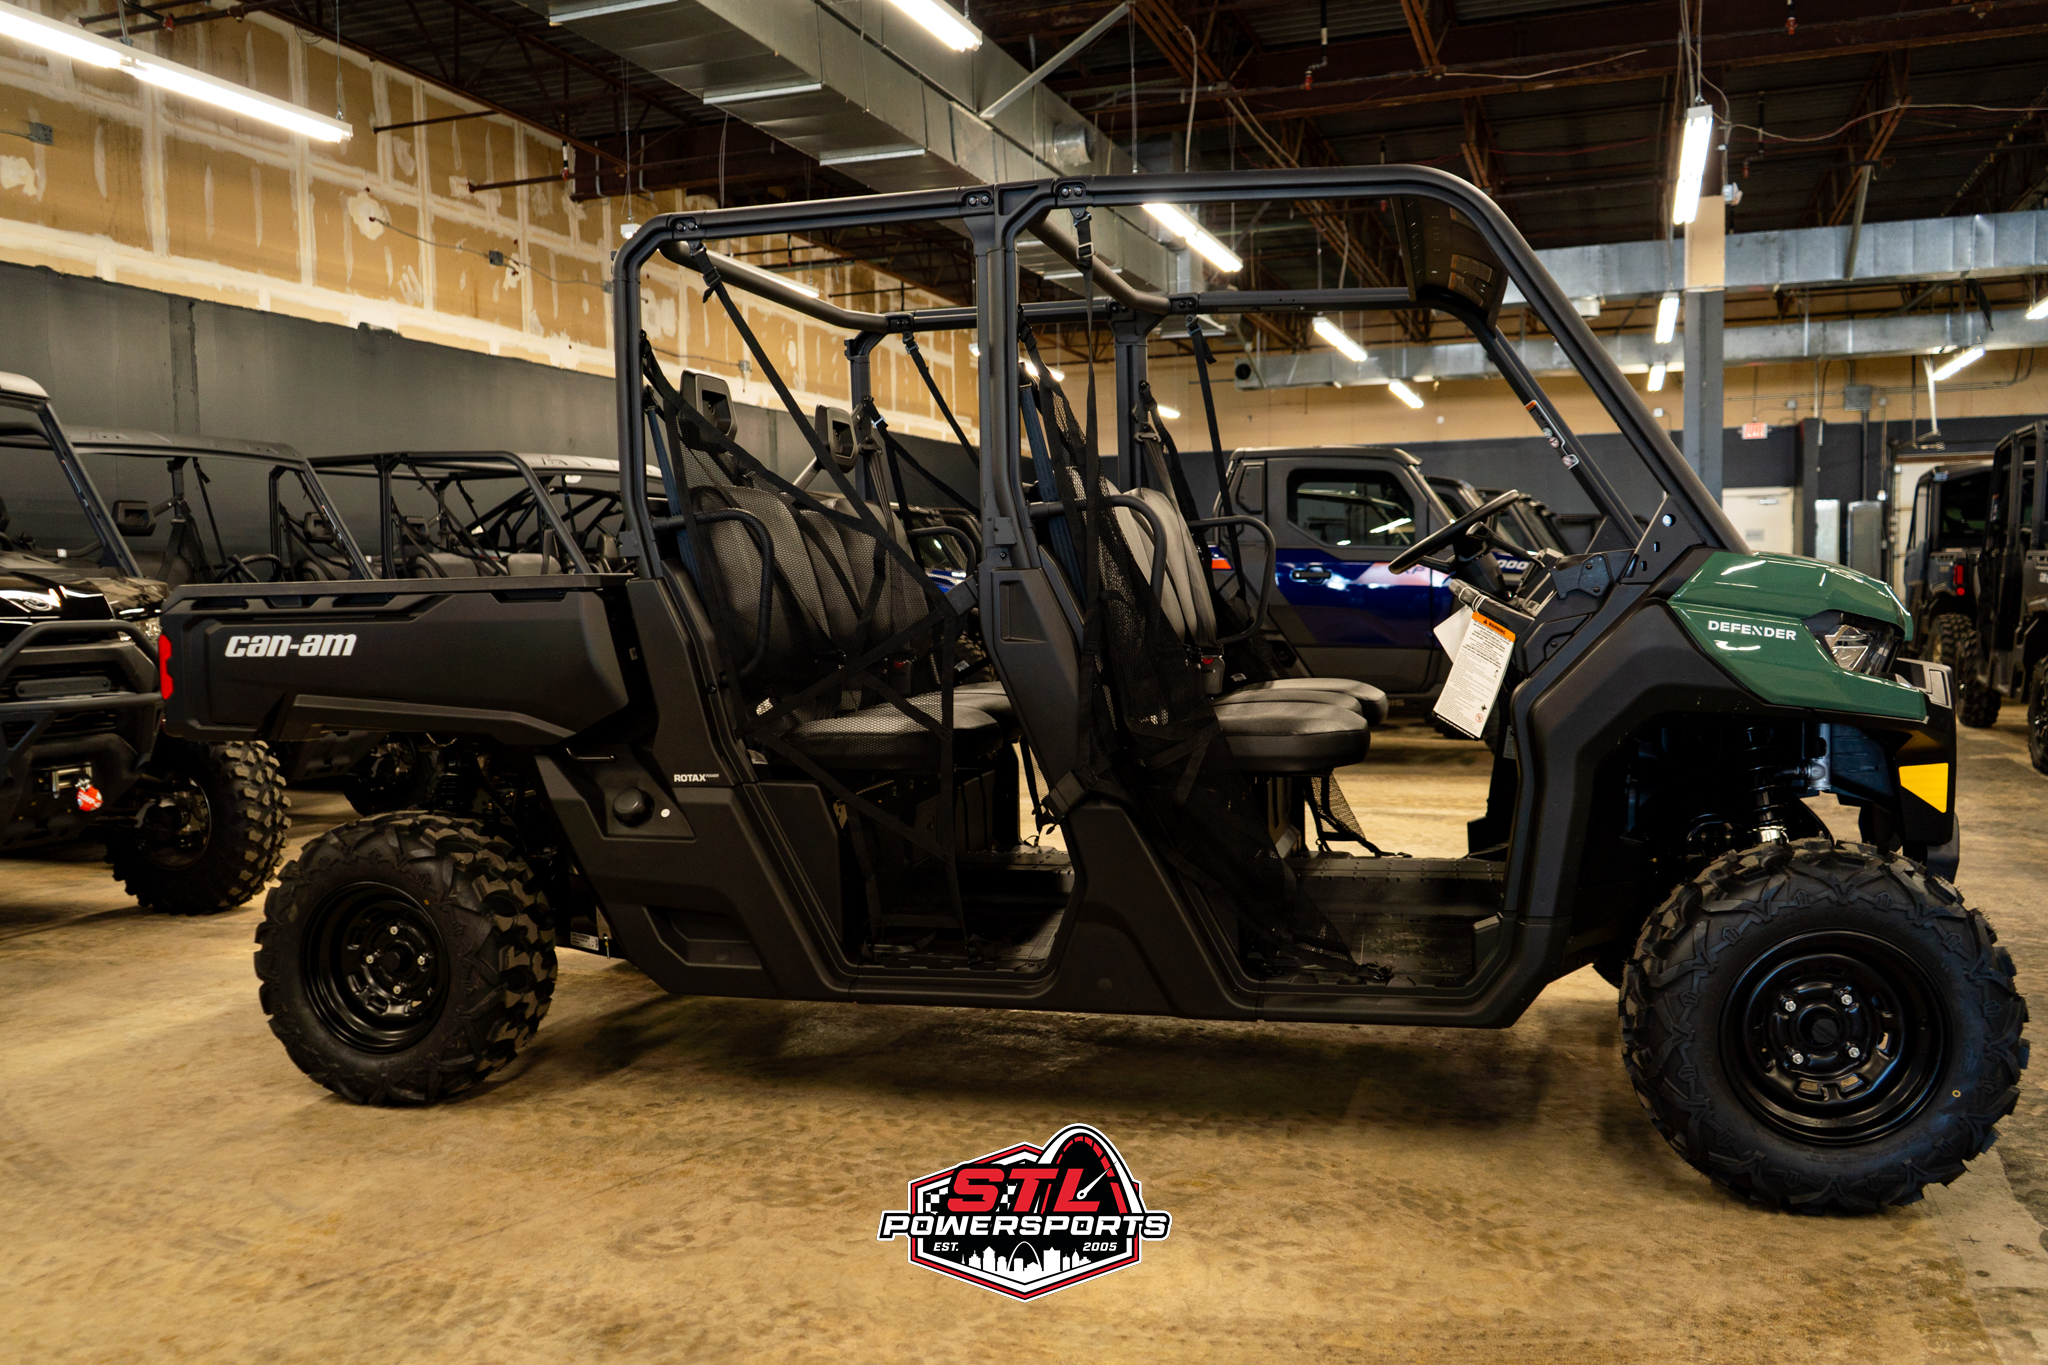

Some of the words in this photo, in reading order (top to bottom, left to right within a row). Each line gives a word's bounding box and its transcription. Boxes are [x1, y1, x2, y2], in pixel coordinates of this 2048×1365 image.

[1496, 558, 1530, 570] 000
[1488, 621, 1507, 635] WARNING
[1707, 620, 1797, 641] DEFENDER
[225, 634, 357, 657] can-am
[673, 773, 706, 782] ROTAX
